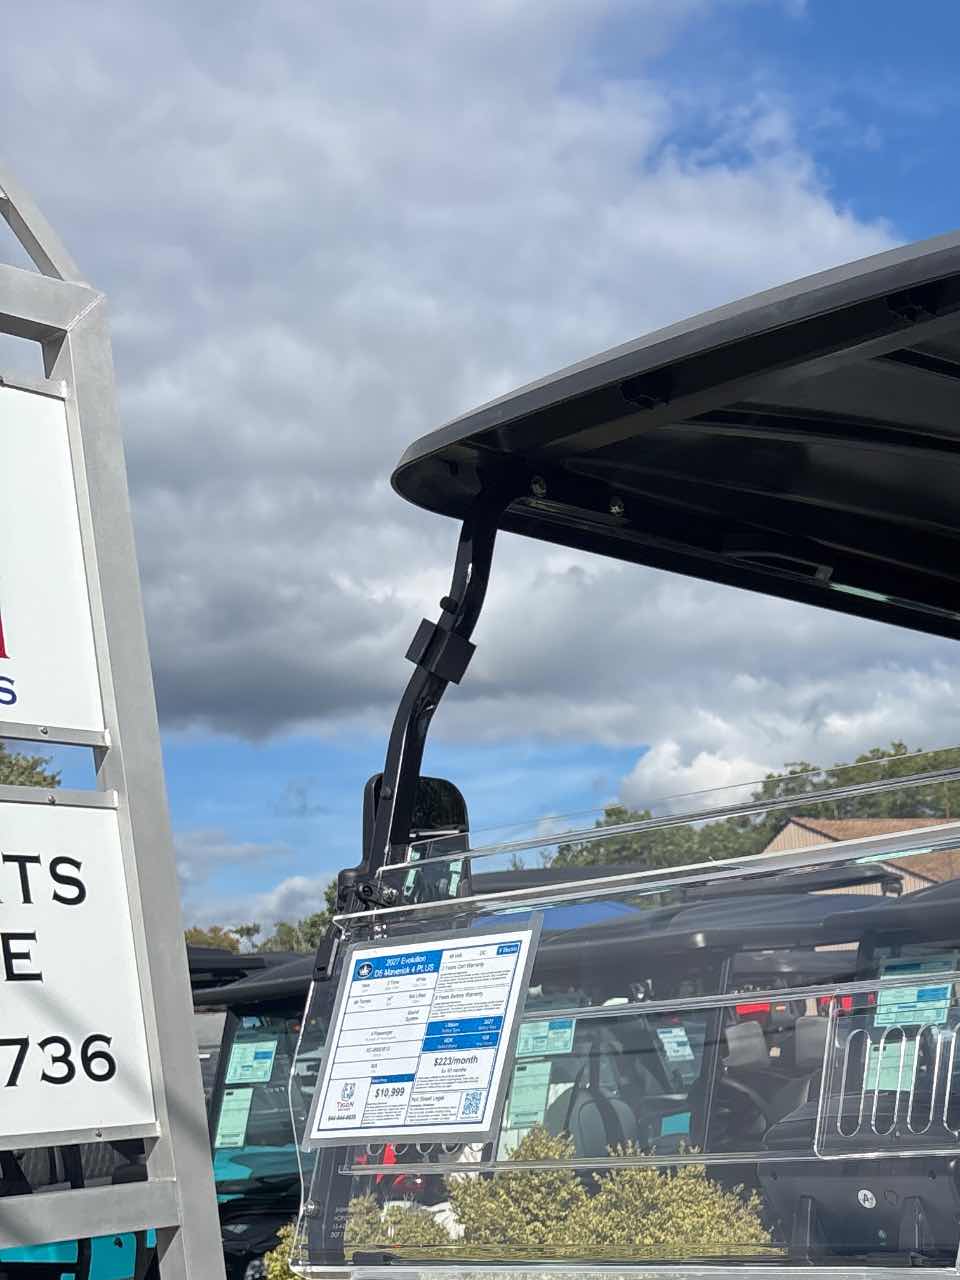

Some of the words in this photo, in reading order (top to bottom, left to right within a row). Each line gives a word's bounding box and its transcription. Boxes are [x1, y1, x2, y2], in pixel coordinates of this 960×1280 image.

[0, 853, 87, 906] TS
[416, 963, 435, 973] PLUS
[0, 1034, 117, 1088] 736
[434, 1055, 479, 1067] $223/month
[375, 1086, 406, 1099] $10,999
